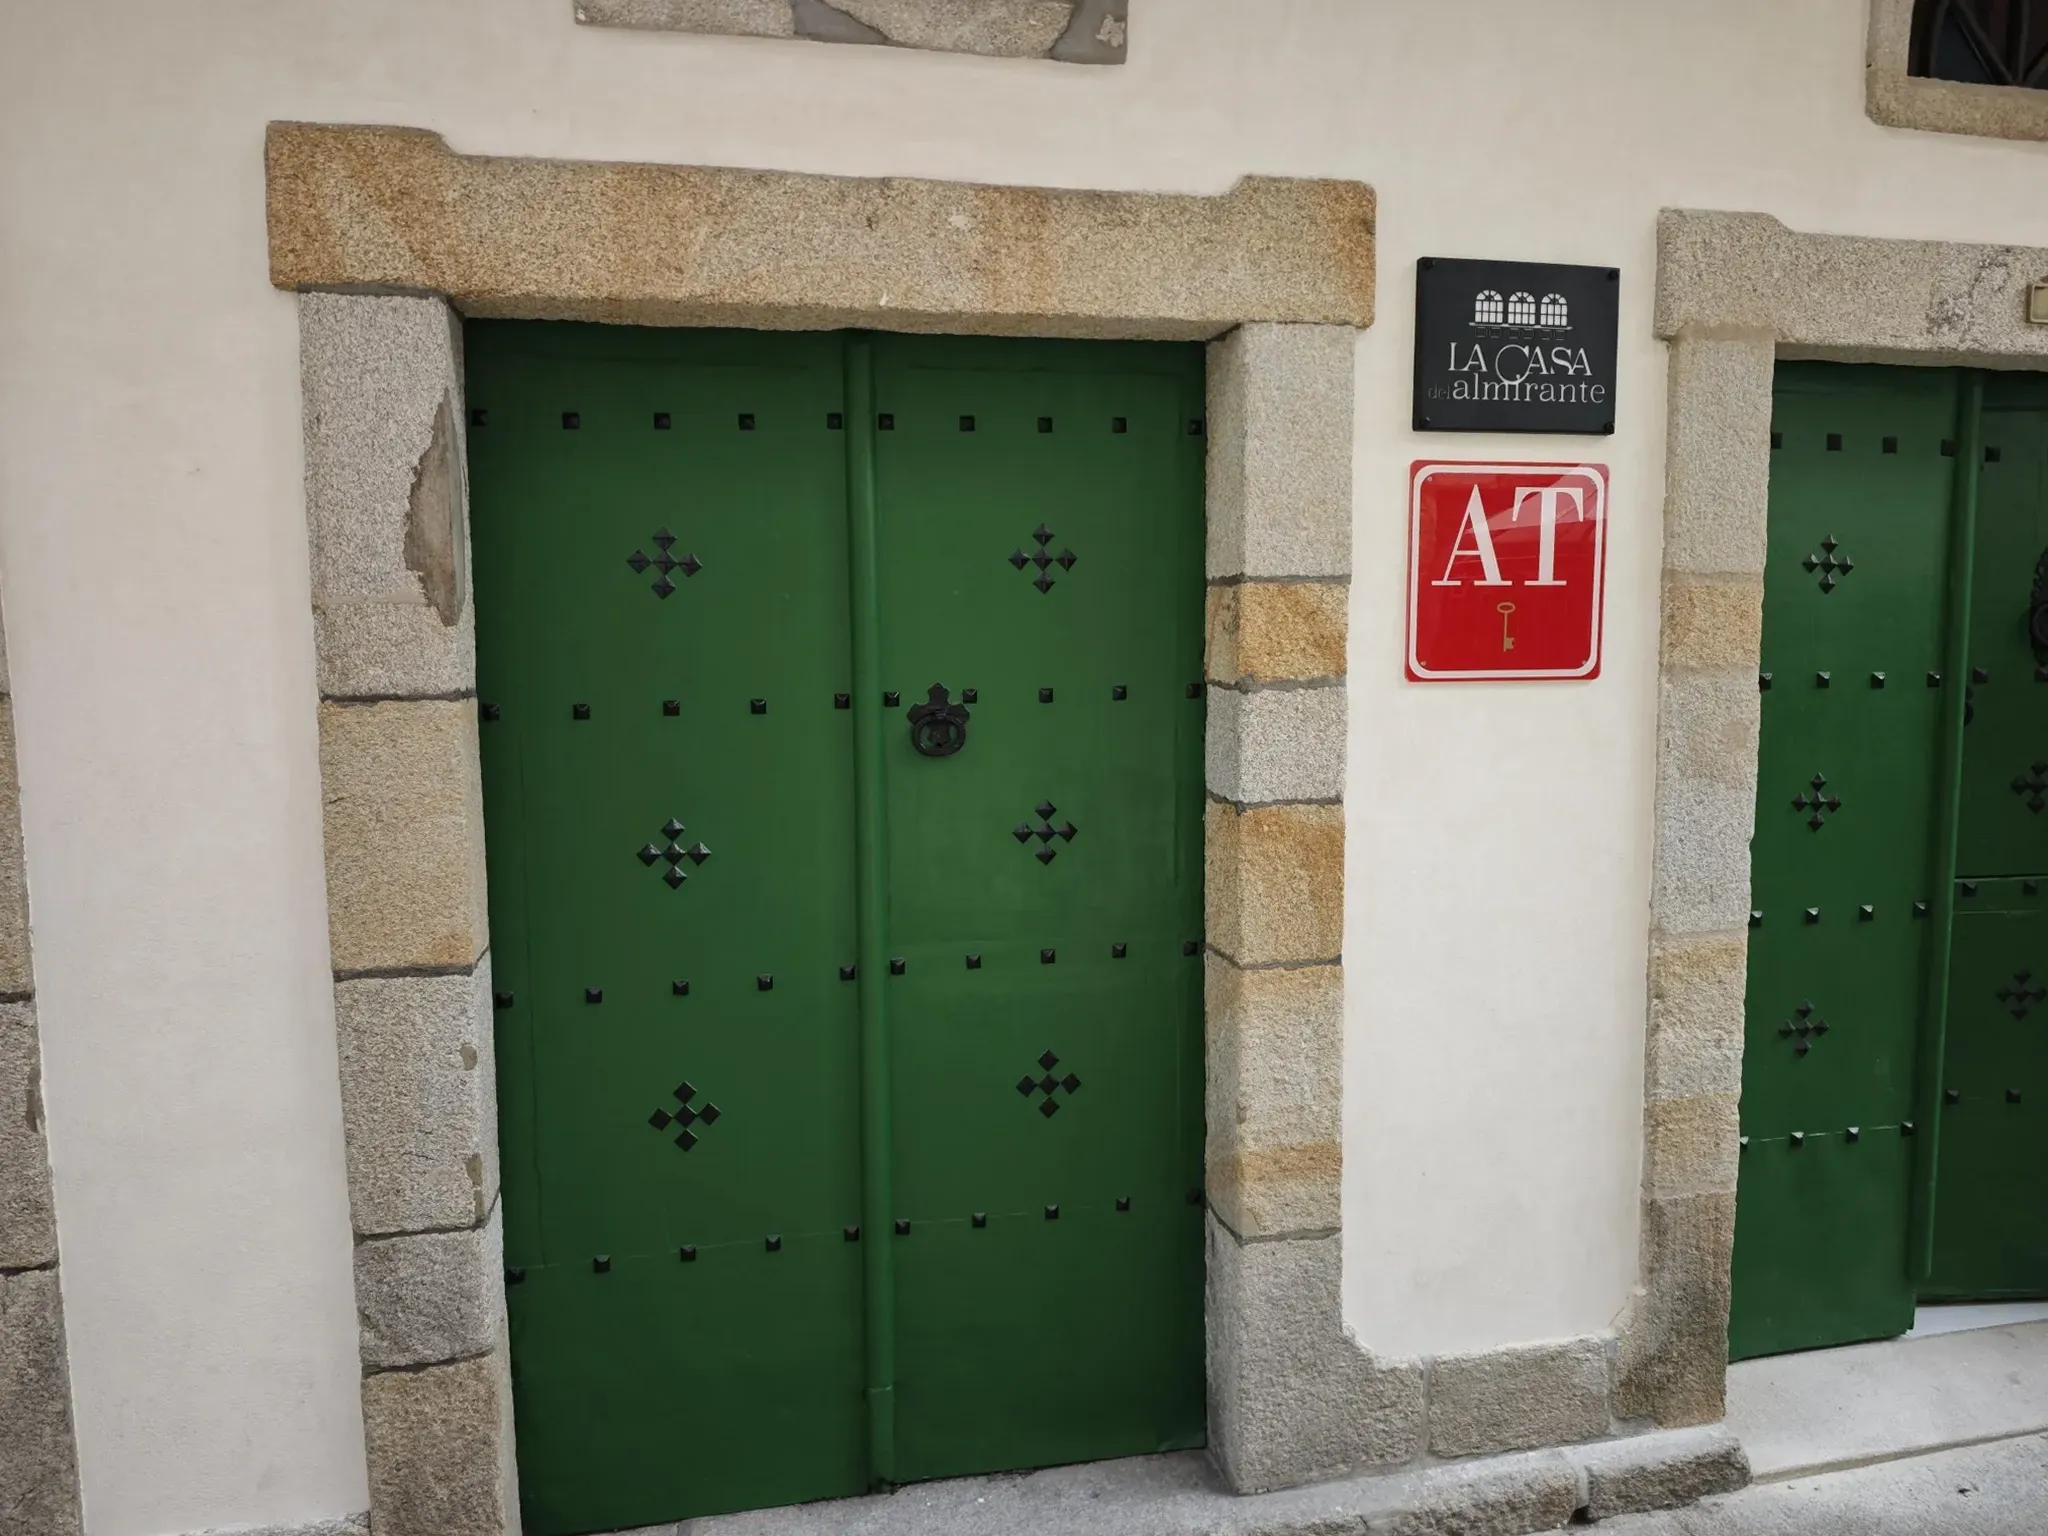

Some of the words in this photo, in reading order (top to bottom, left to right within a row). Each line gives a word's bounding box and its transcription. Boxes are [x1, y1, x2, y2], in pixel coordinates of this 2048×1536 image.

[1448, 342, 1488, 372] LA
[1495, 344, 1593, 385] CASA
[1428, 382, 1450, 400] del
[1452, 372, 1606, 403] almirante
[1431, 484, 1584, 586] AT
